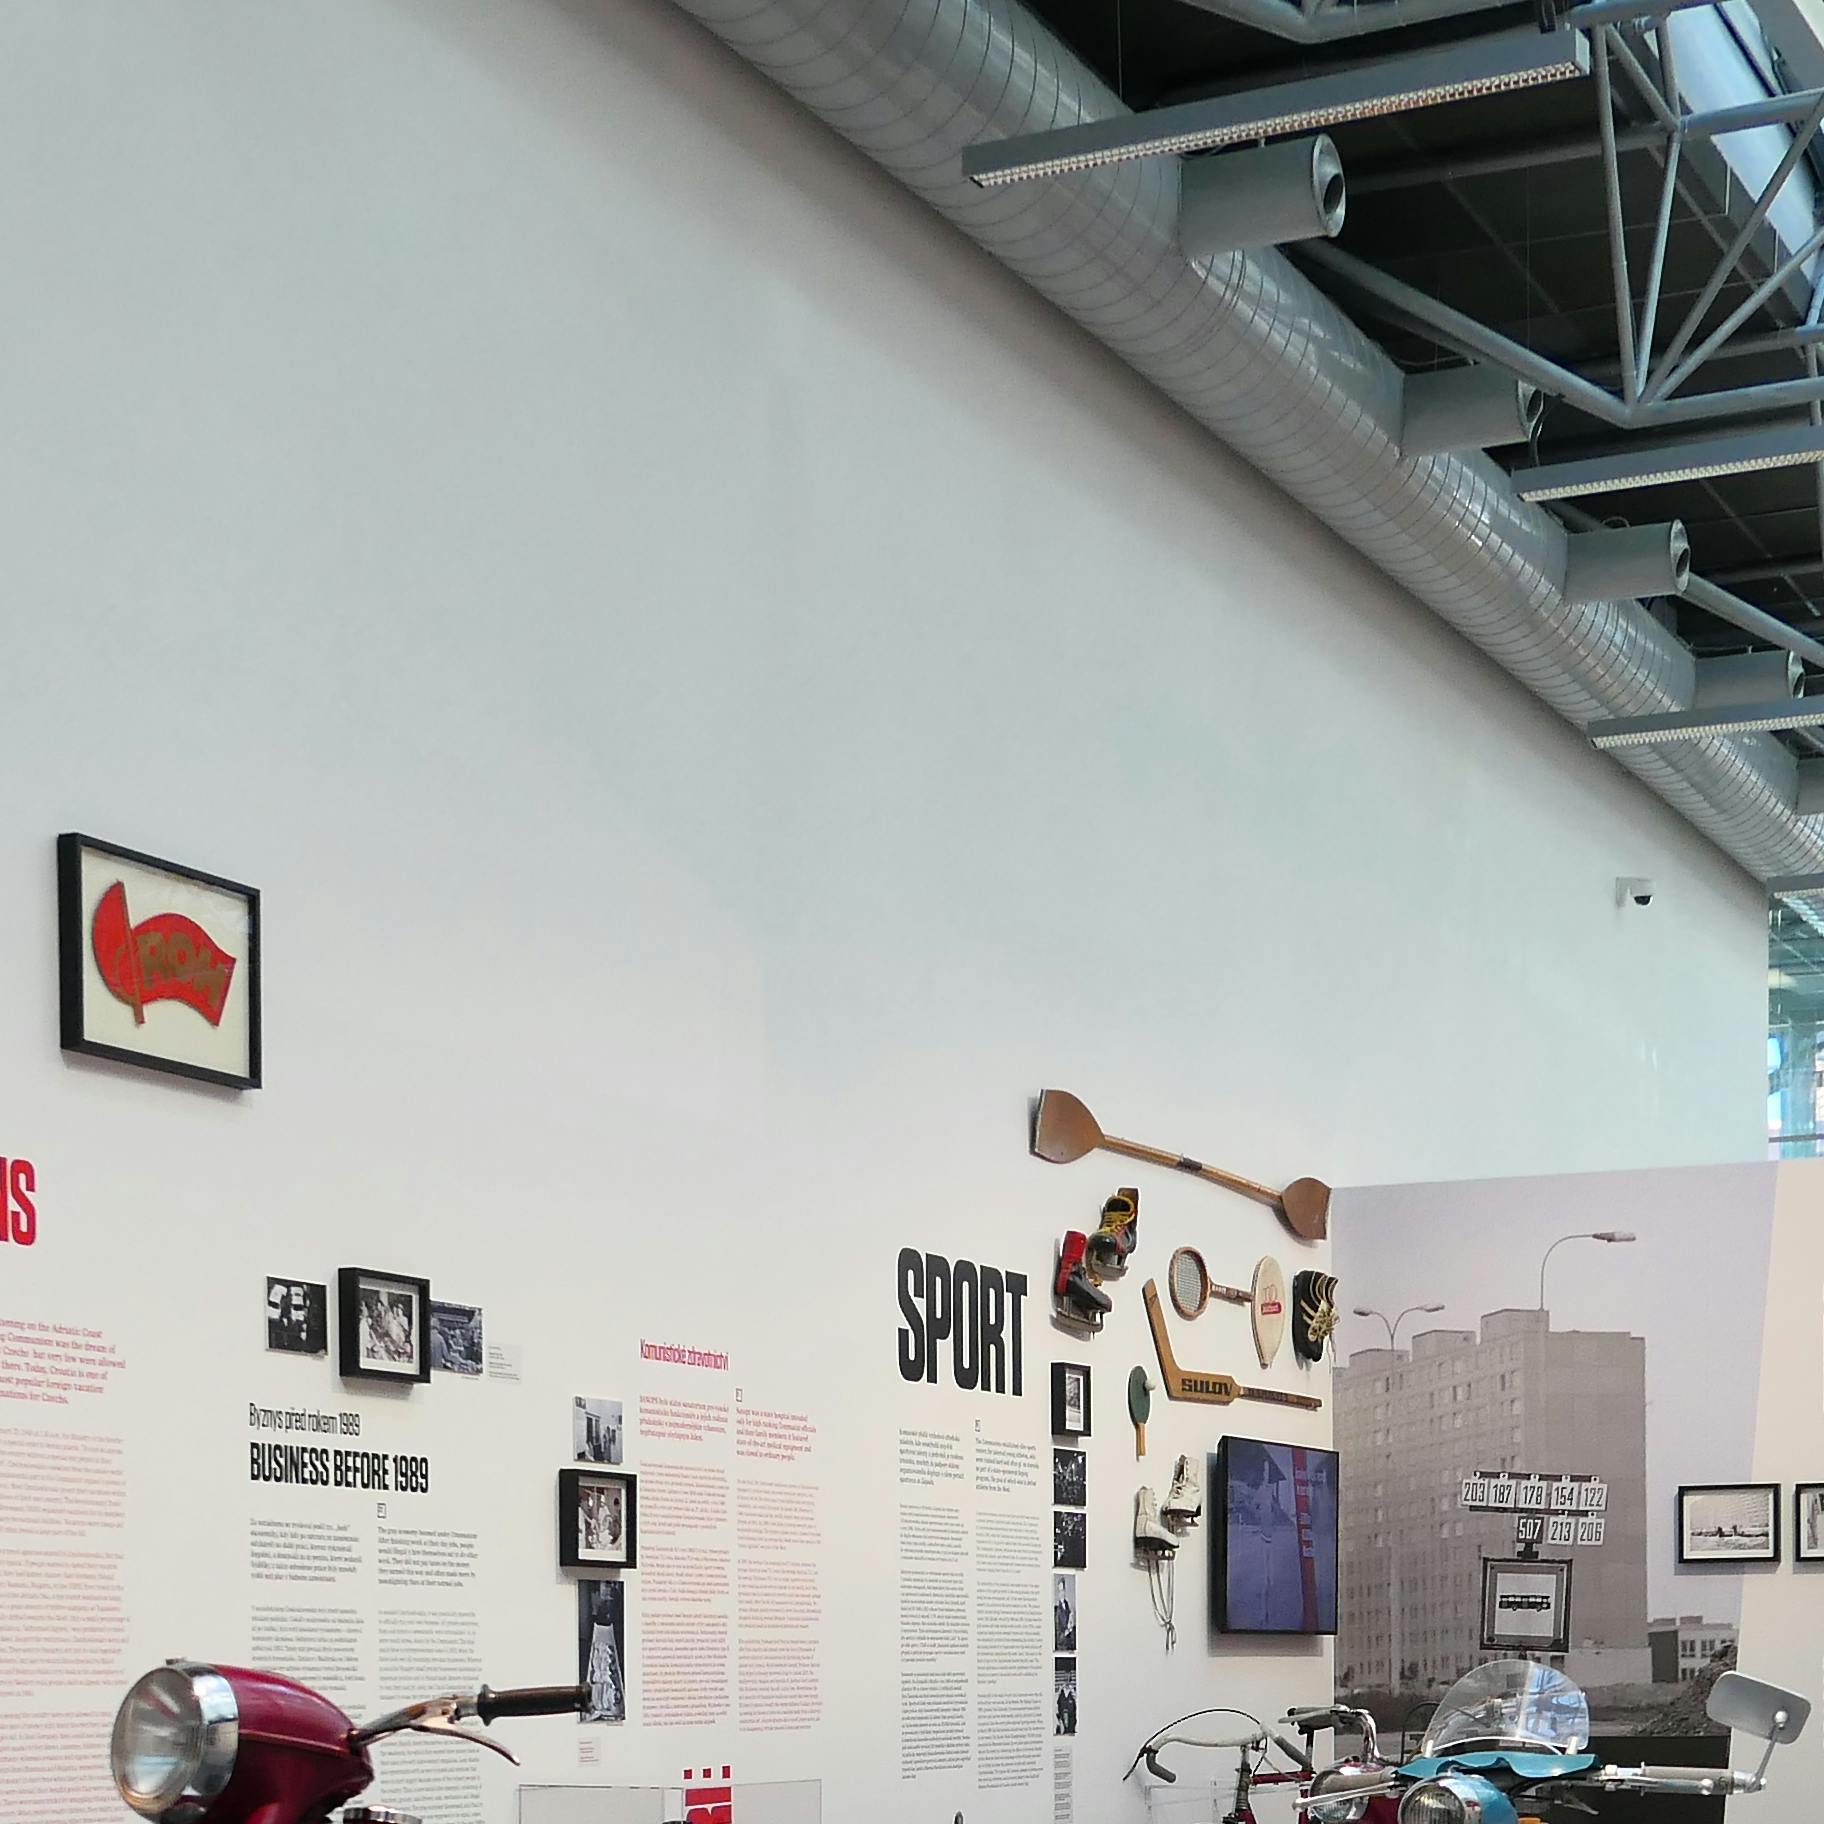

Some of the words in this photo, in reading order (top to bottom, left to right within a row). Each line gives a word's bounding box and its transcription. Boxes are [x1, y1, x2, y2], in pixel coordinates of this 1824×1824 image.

[898, 1247, 1028, 1397] SPORT
[250, 1442, 330, 1486] BUSINESS
[334, 1449, 389, 1490] BEFORE
[393, 1454, 429, 1493] 1989
[1464, 1483, 1485, 1502] 203
[1493, 1484, 1512, 1503] 187
[1523, 1486, 1542, 1504] 178
[1555, 1487, 1574, 1505] 154
[1584, 1488, 1603, 1506] 122
[1519, 1519, 1541, 1539] 507
[1551, 1522, 1571, 1541] 213
[1580, 1523, 1601, 1541] 206
